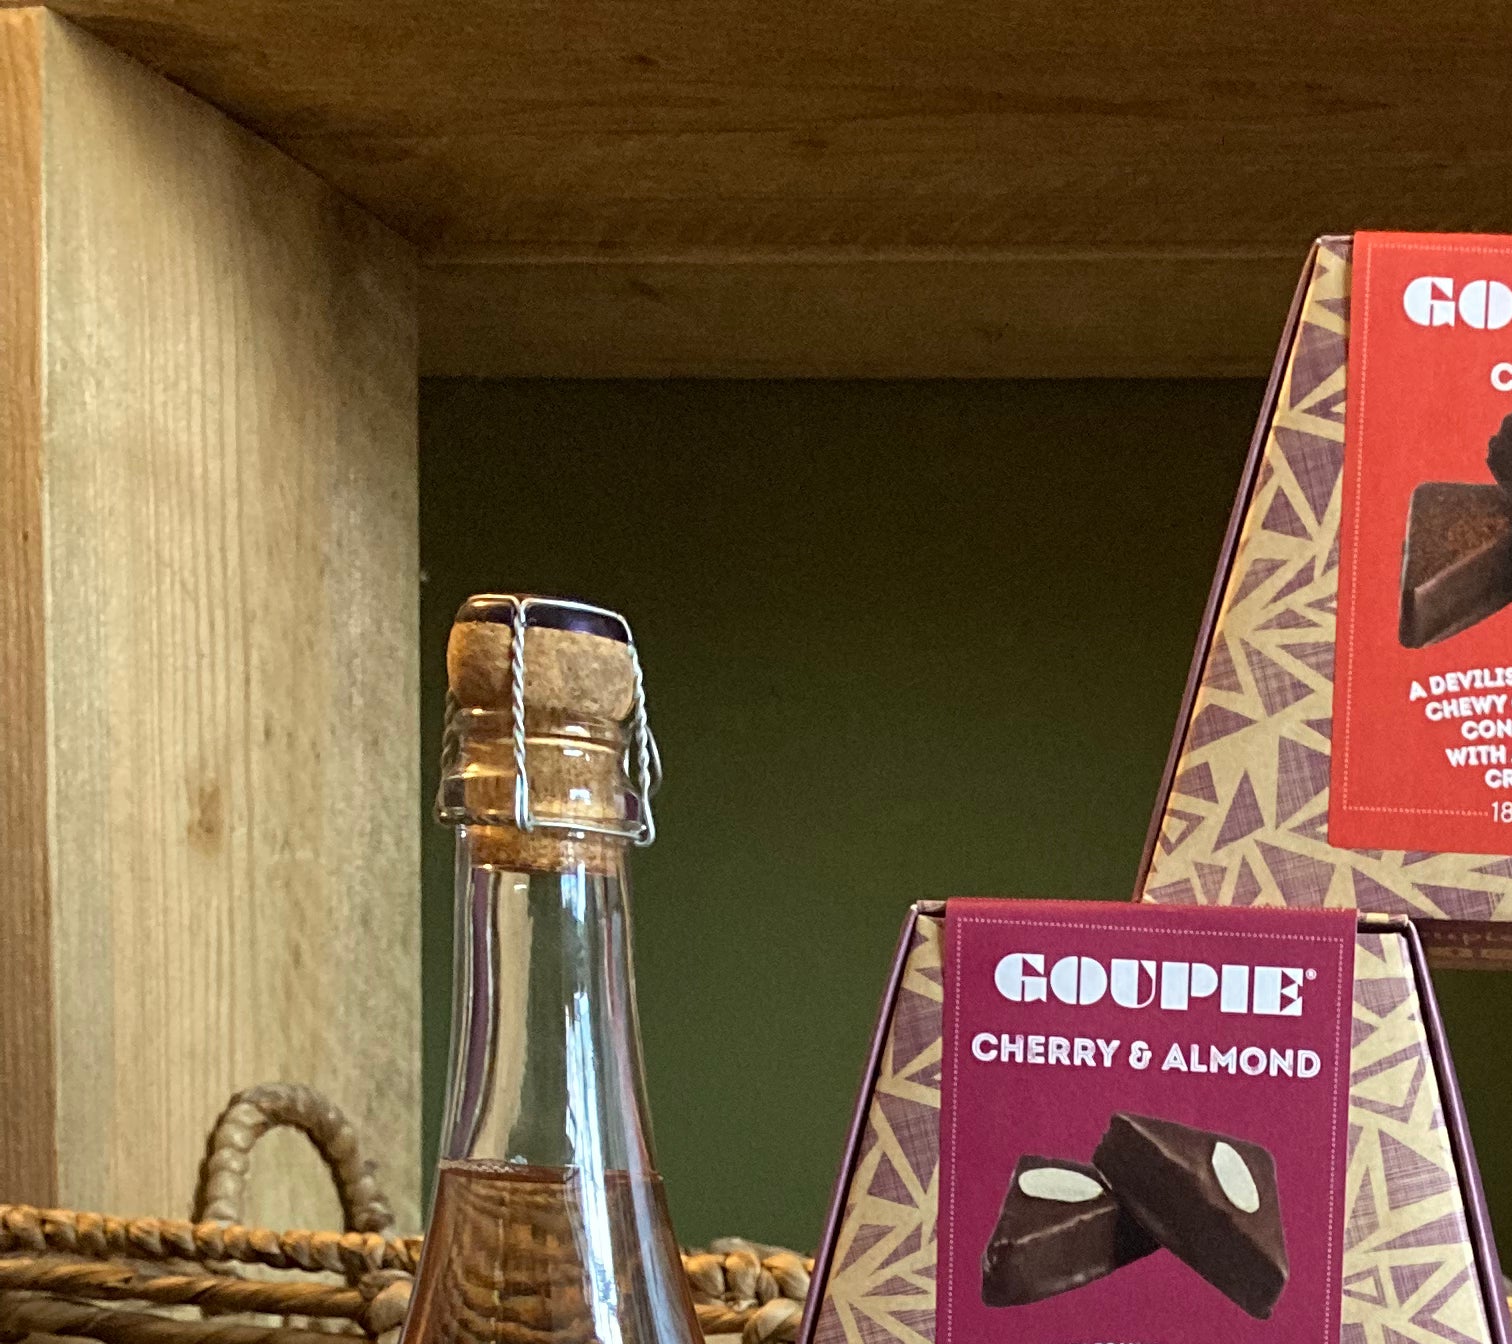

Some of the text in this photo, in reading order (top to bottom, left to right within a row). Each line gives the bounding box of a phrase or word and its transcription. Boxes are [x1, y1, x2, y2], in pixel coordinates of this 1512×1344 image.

[1410, 682, 1427, 701] A
[1426, 696, 1507, 722] CHEWY
[1446, 746, 1506, 766] WITH
[972, 1033, 1321, 1078] CHERRY & ALMOND
